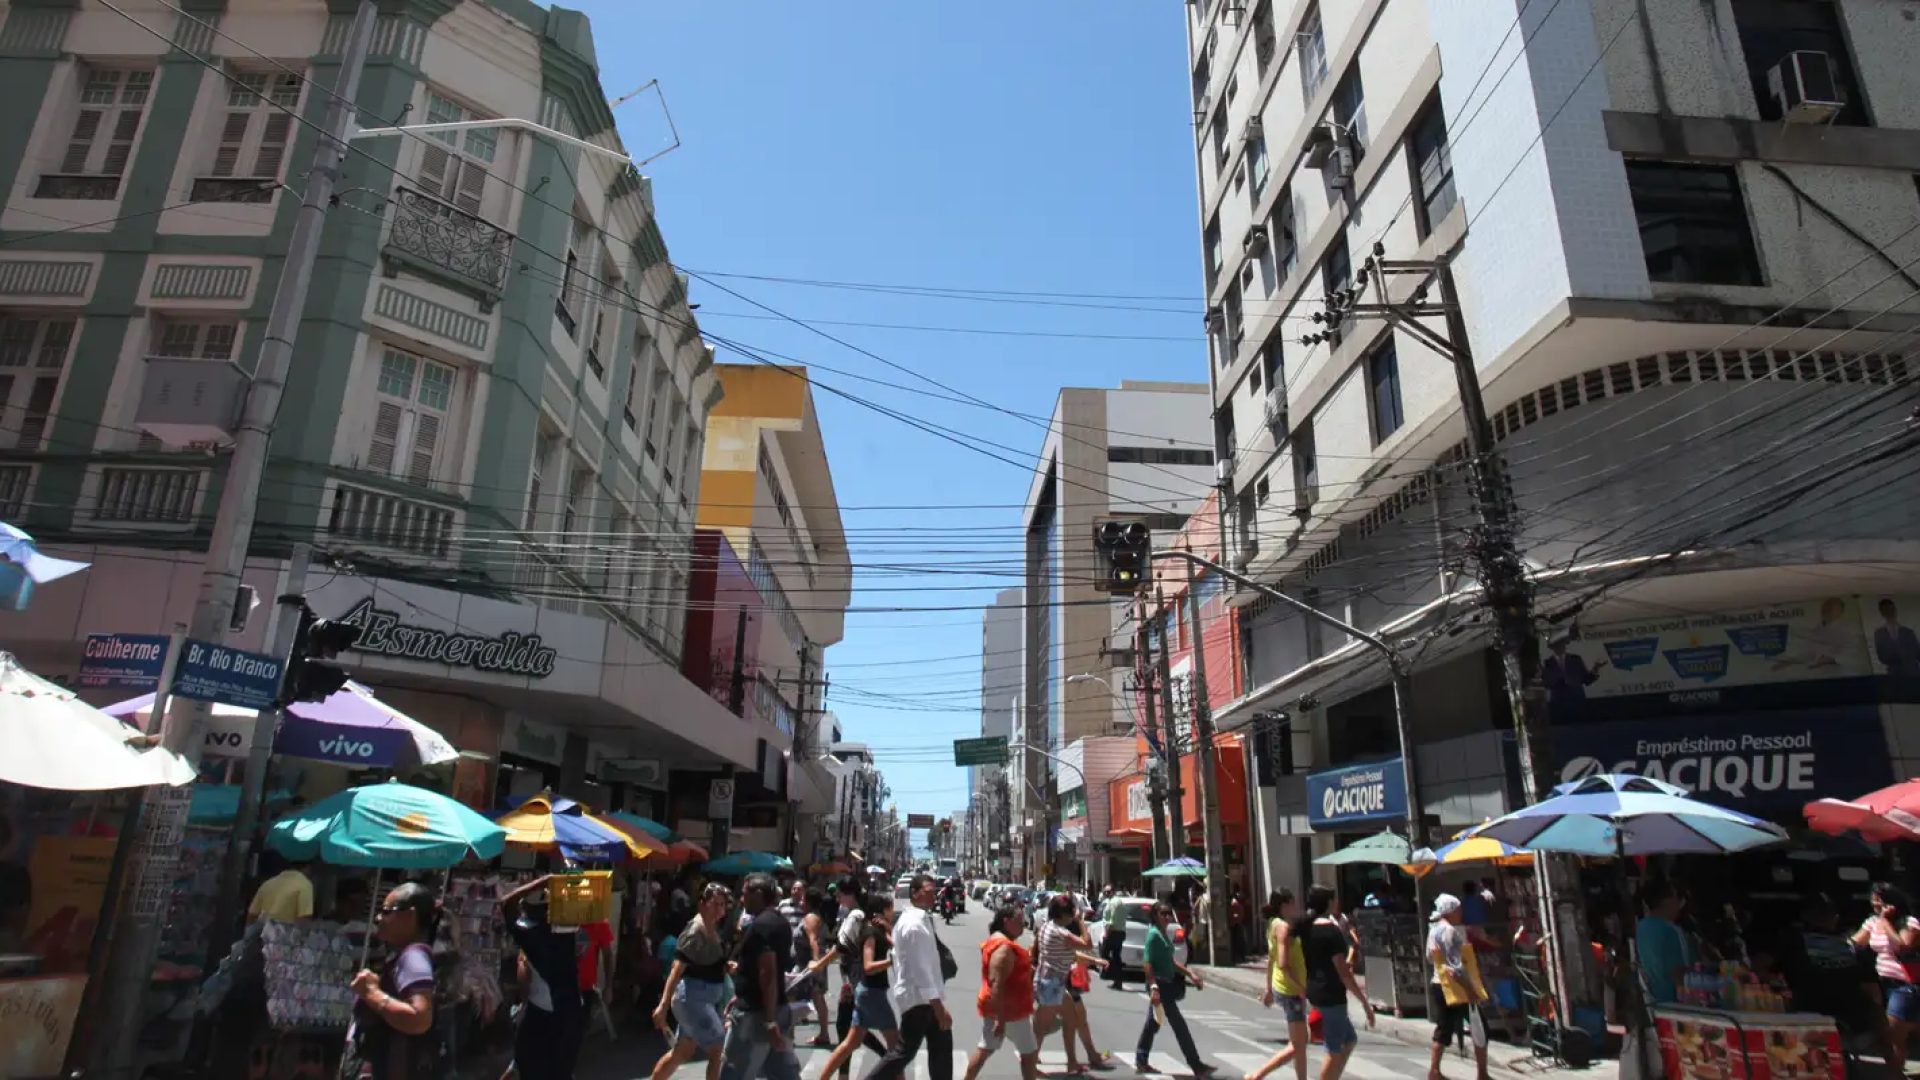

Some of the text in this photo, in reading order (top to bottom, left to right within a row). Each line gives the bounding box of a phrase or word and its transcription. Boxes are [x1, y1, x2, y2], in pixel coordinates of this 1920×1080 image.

[85, 637, 161, 662] Guilherme
[352, 613, 557, 675] Esmeralda
[187, 643, 205, 666] Br.
[232, 653, 278, 680] Branco
[204, 731, 242, 748] ivo
[318, 733, 375, 758] vivo
[1636, 730, 1812, 758] Empréstimo Pessoal
[1335, 783, 1384, 815] CACIQUE
